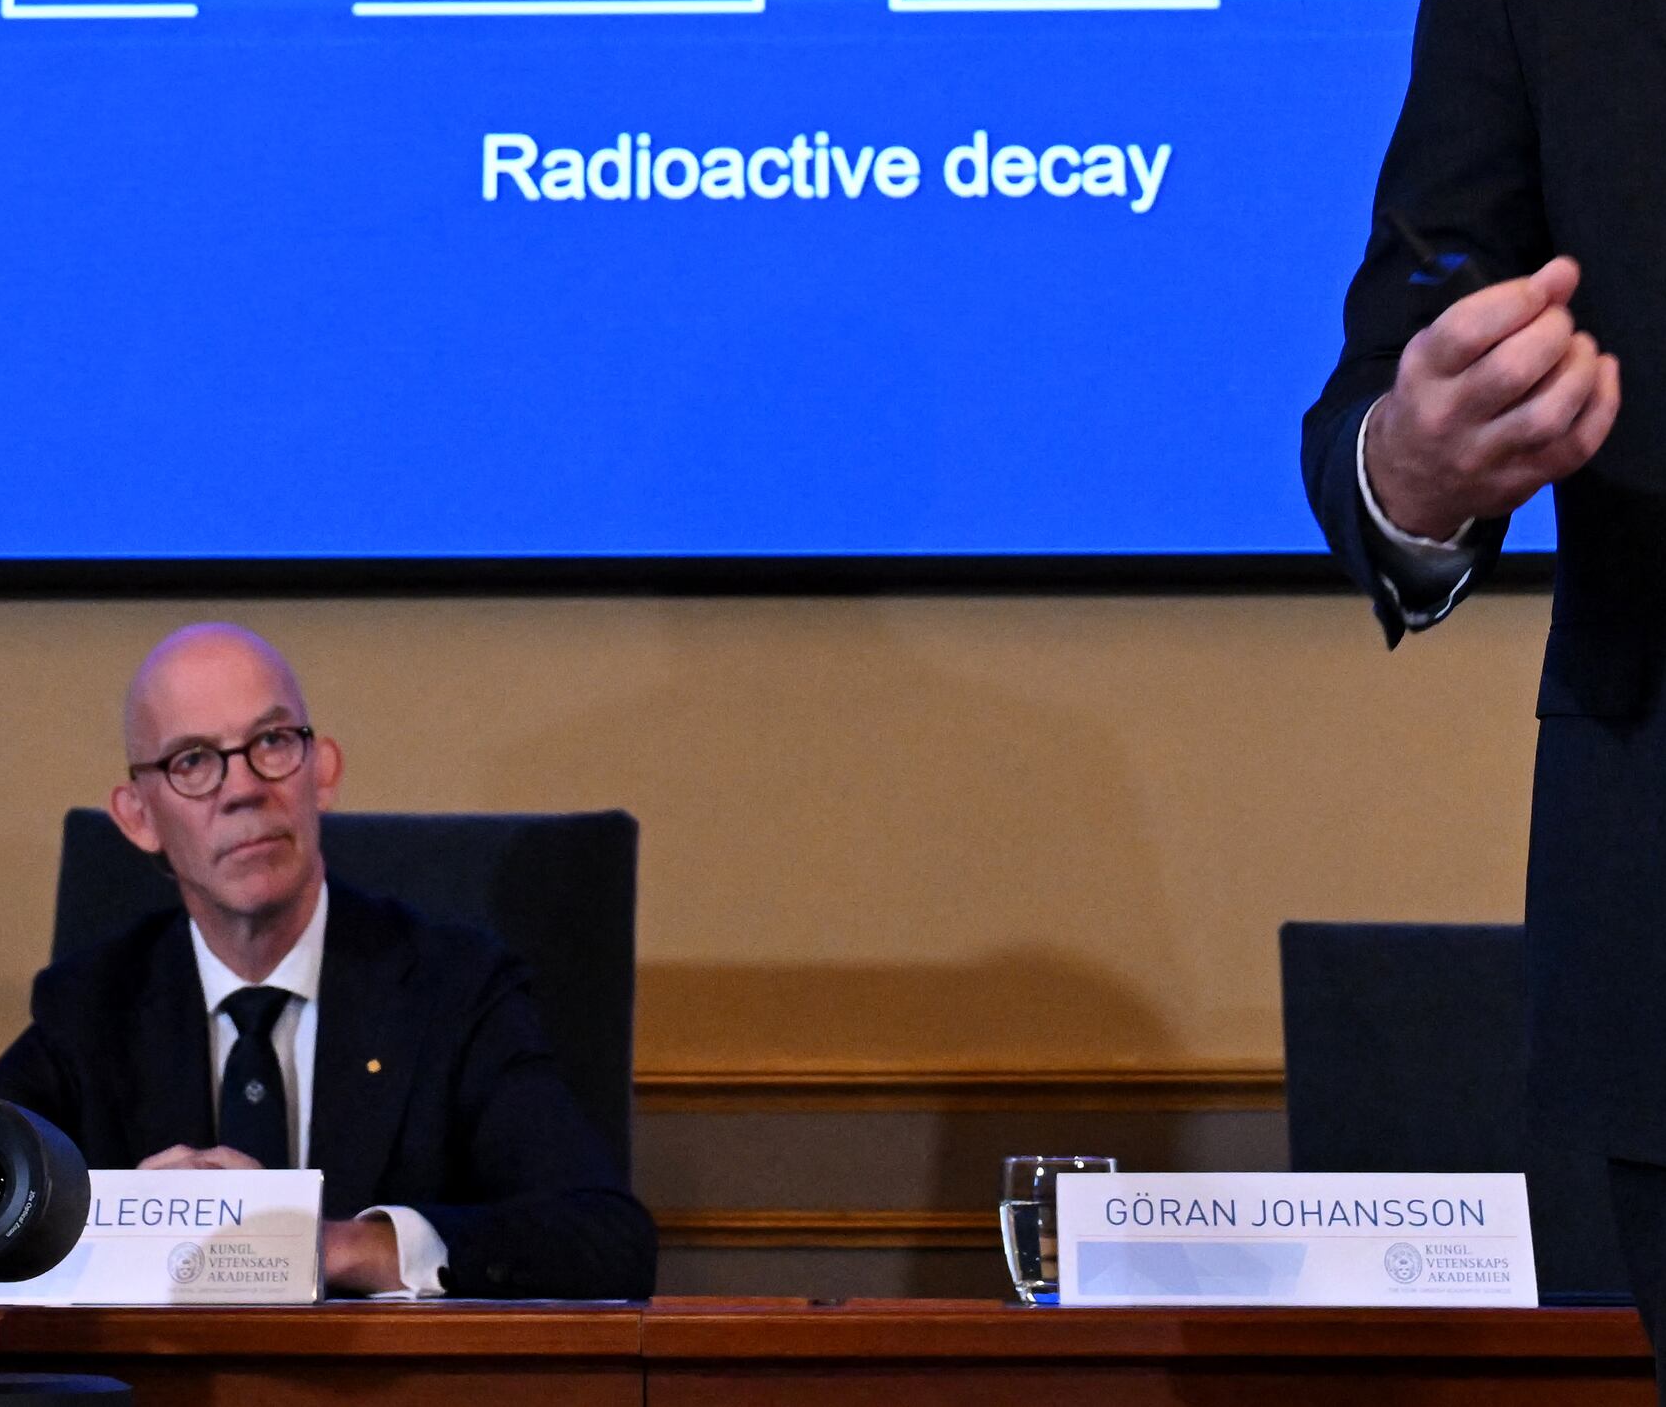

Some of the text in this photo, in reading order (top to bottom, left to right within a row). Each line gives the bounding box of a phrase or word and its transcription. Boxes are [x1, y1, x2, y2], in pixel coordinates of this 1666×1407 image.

[482, 129, 1172, 213] Radioactive decay
[86, 1198, 243, 1227] LEGREN
[1105, 1192, 1485, 1227] GÖRAN JOHANSSON
[207, 1271, 290, 1282] AKADEMIEN
[1427, 1271, 1511, 1283] AKADEMIEN
